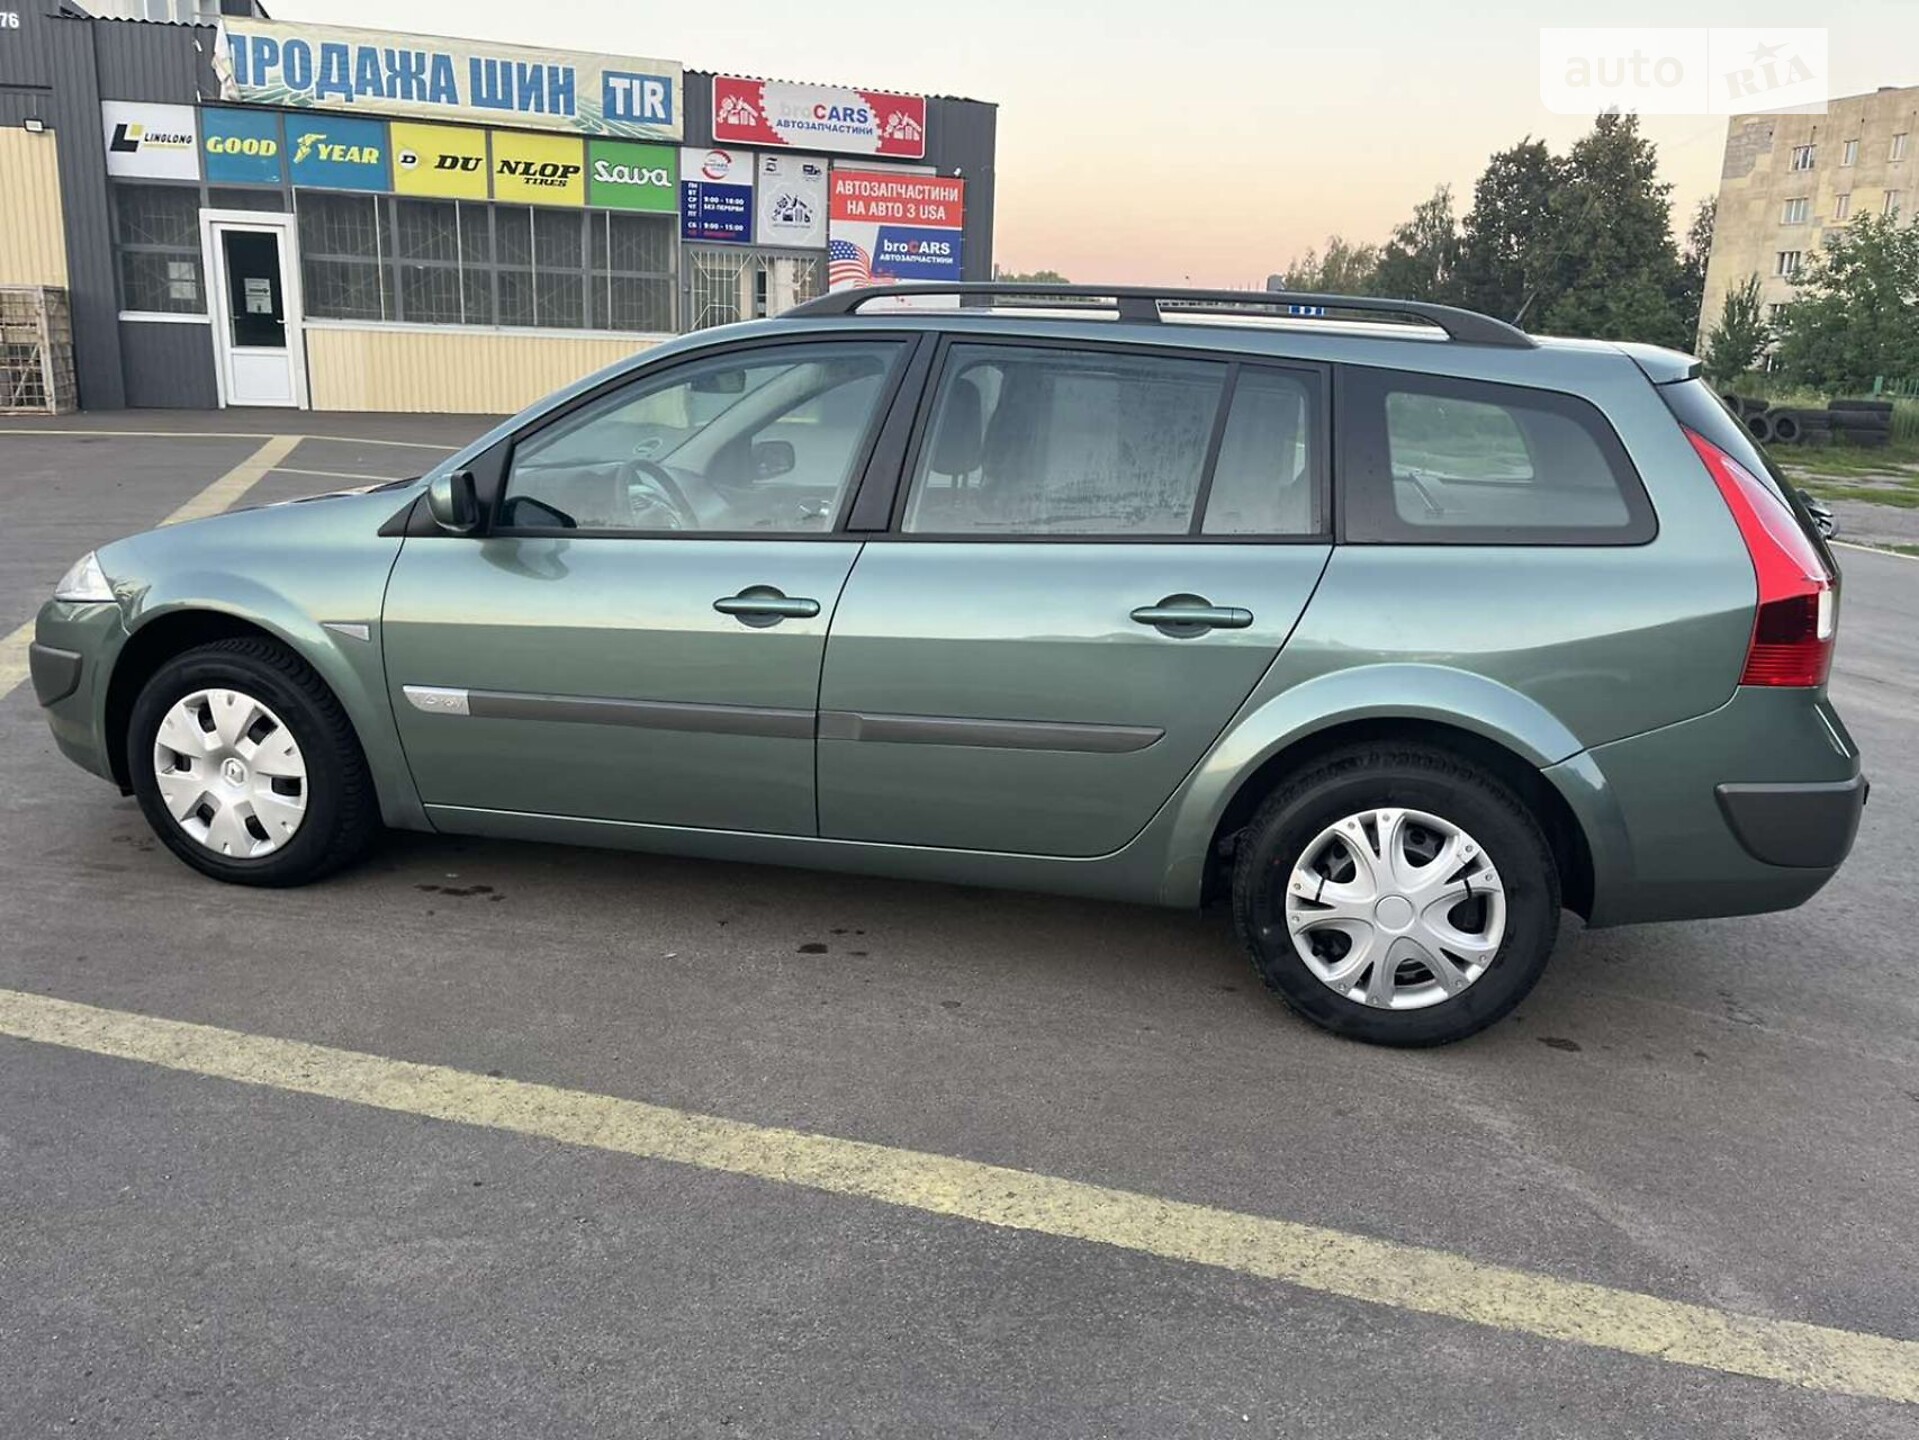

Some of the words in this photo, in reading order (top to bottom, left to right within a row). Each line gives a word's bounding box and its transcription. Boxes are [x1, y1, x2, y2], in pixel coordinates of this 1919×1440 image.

[0, 12, 19, 28] 76
[226, 33, 460, 105] ПРОДАЖА
[469, 57, 576, 117] ШИН
[609, 76, 667, 119] TIR
[780, 103, 868, 124] broCARS
[776, 119, 873, 136] АВТОЗАПЧАСТИНИ
[144, 132, 192, 145] LINGLONG
[206, 136, 277, 157] GOOD
[317, 143, 380, 165] YEAR
[434, 154, 483, 172] DU
[497, 160, 581, 179] NLOP
[524, 177, 568, 188] TIRES
[593, 158, 672, 188] Sava
[835, 179, 958, 202] АВТОЗАПЧАСТИНИ
[847, 200, 865, 215] НА
[869, 202, 903, 218] АВТО
[919, 205, 946, 220] USA
[883, 239, 951, 255] broCARS
[880, 253, 954, 264] АВТОЗАПЧАСТИНИ
